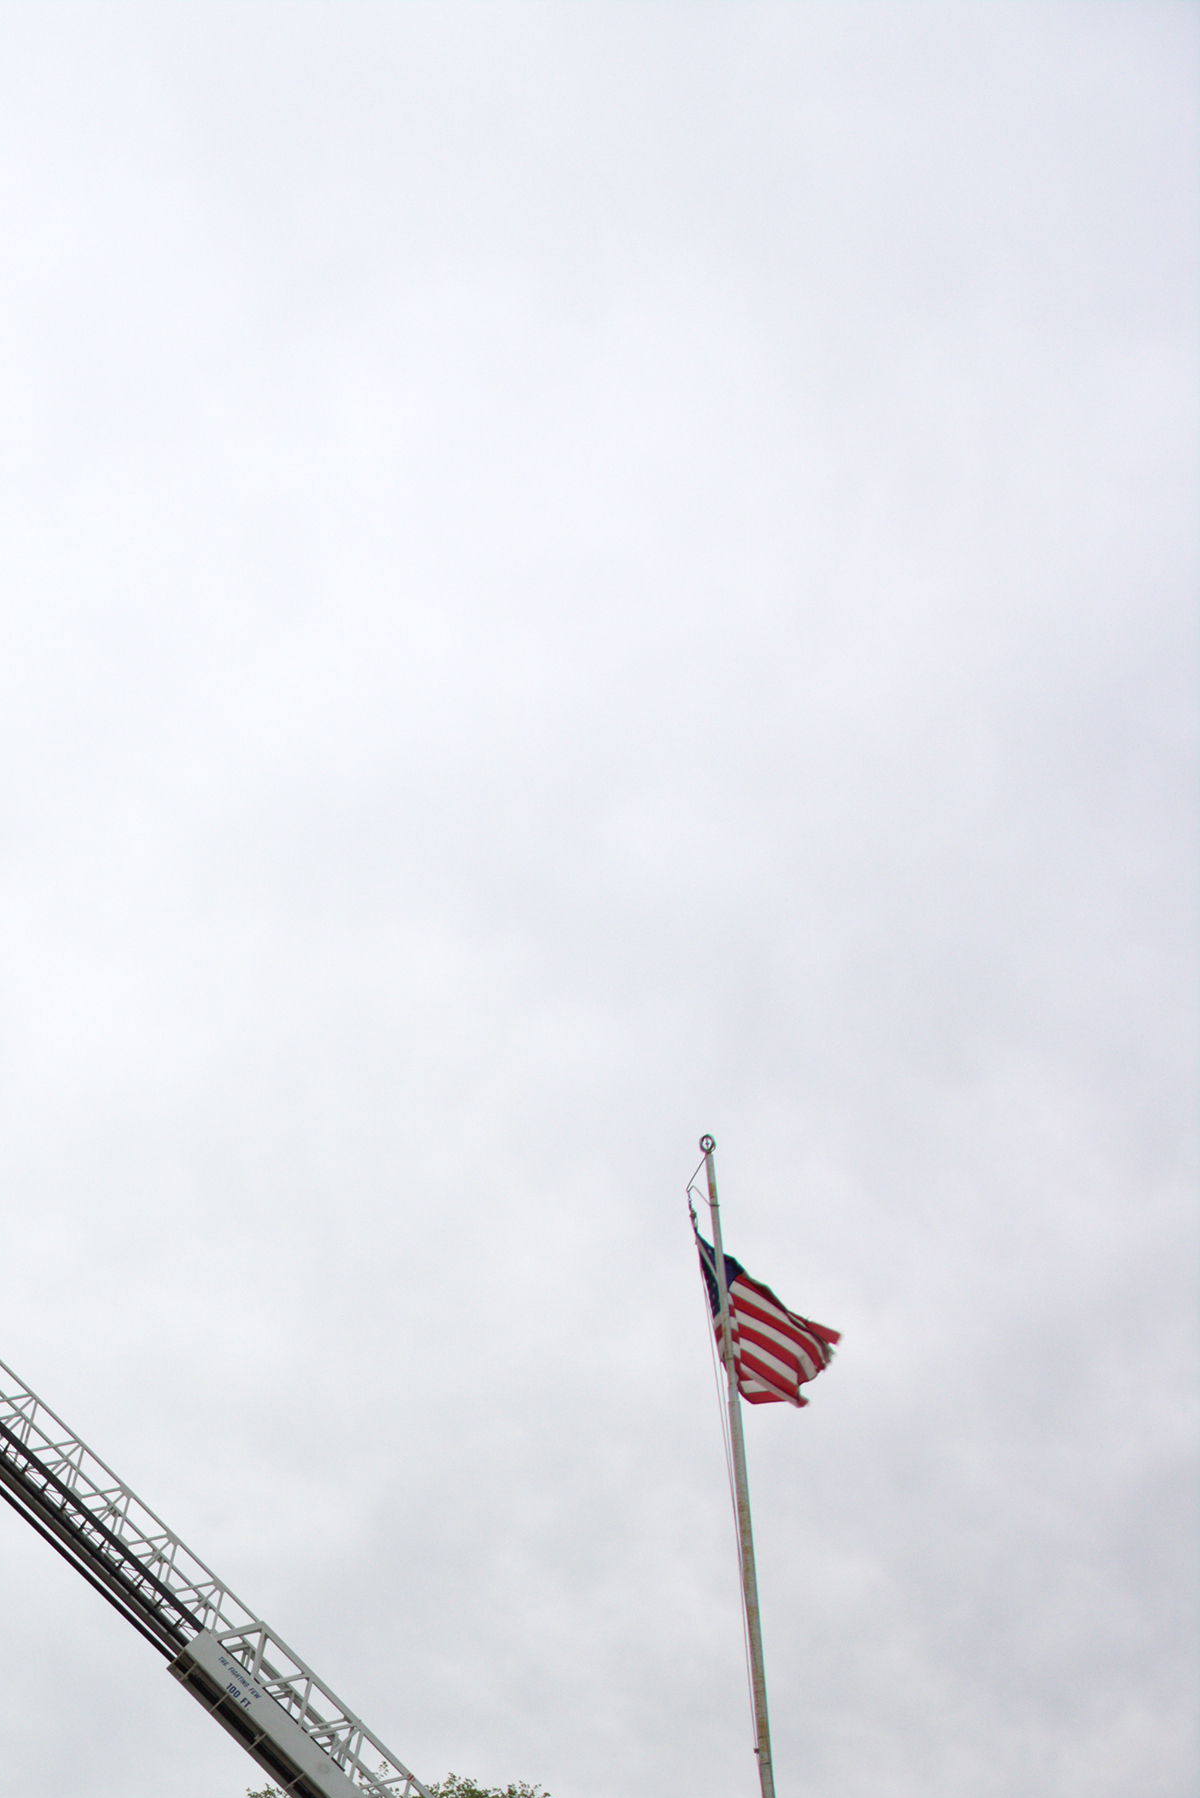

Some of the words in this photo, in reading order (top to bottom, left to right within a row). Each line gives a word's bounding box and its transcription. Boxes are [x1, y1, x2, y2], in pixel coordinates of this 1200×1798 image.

[218, 1656, 230, 1667] THE
[228, 1667, 250, 1688] FIGHTING
[248, 1687, 262, 1699] FEW
[226, 1682, 241, 1698] 100
[240, 1697, 251, 1711] FT.
